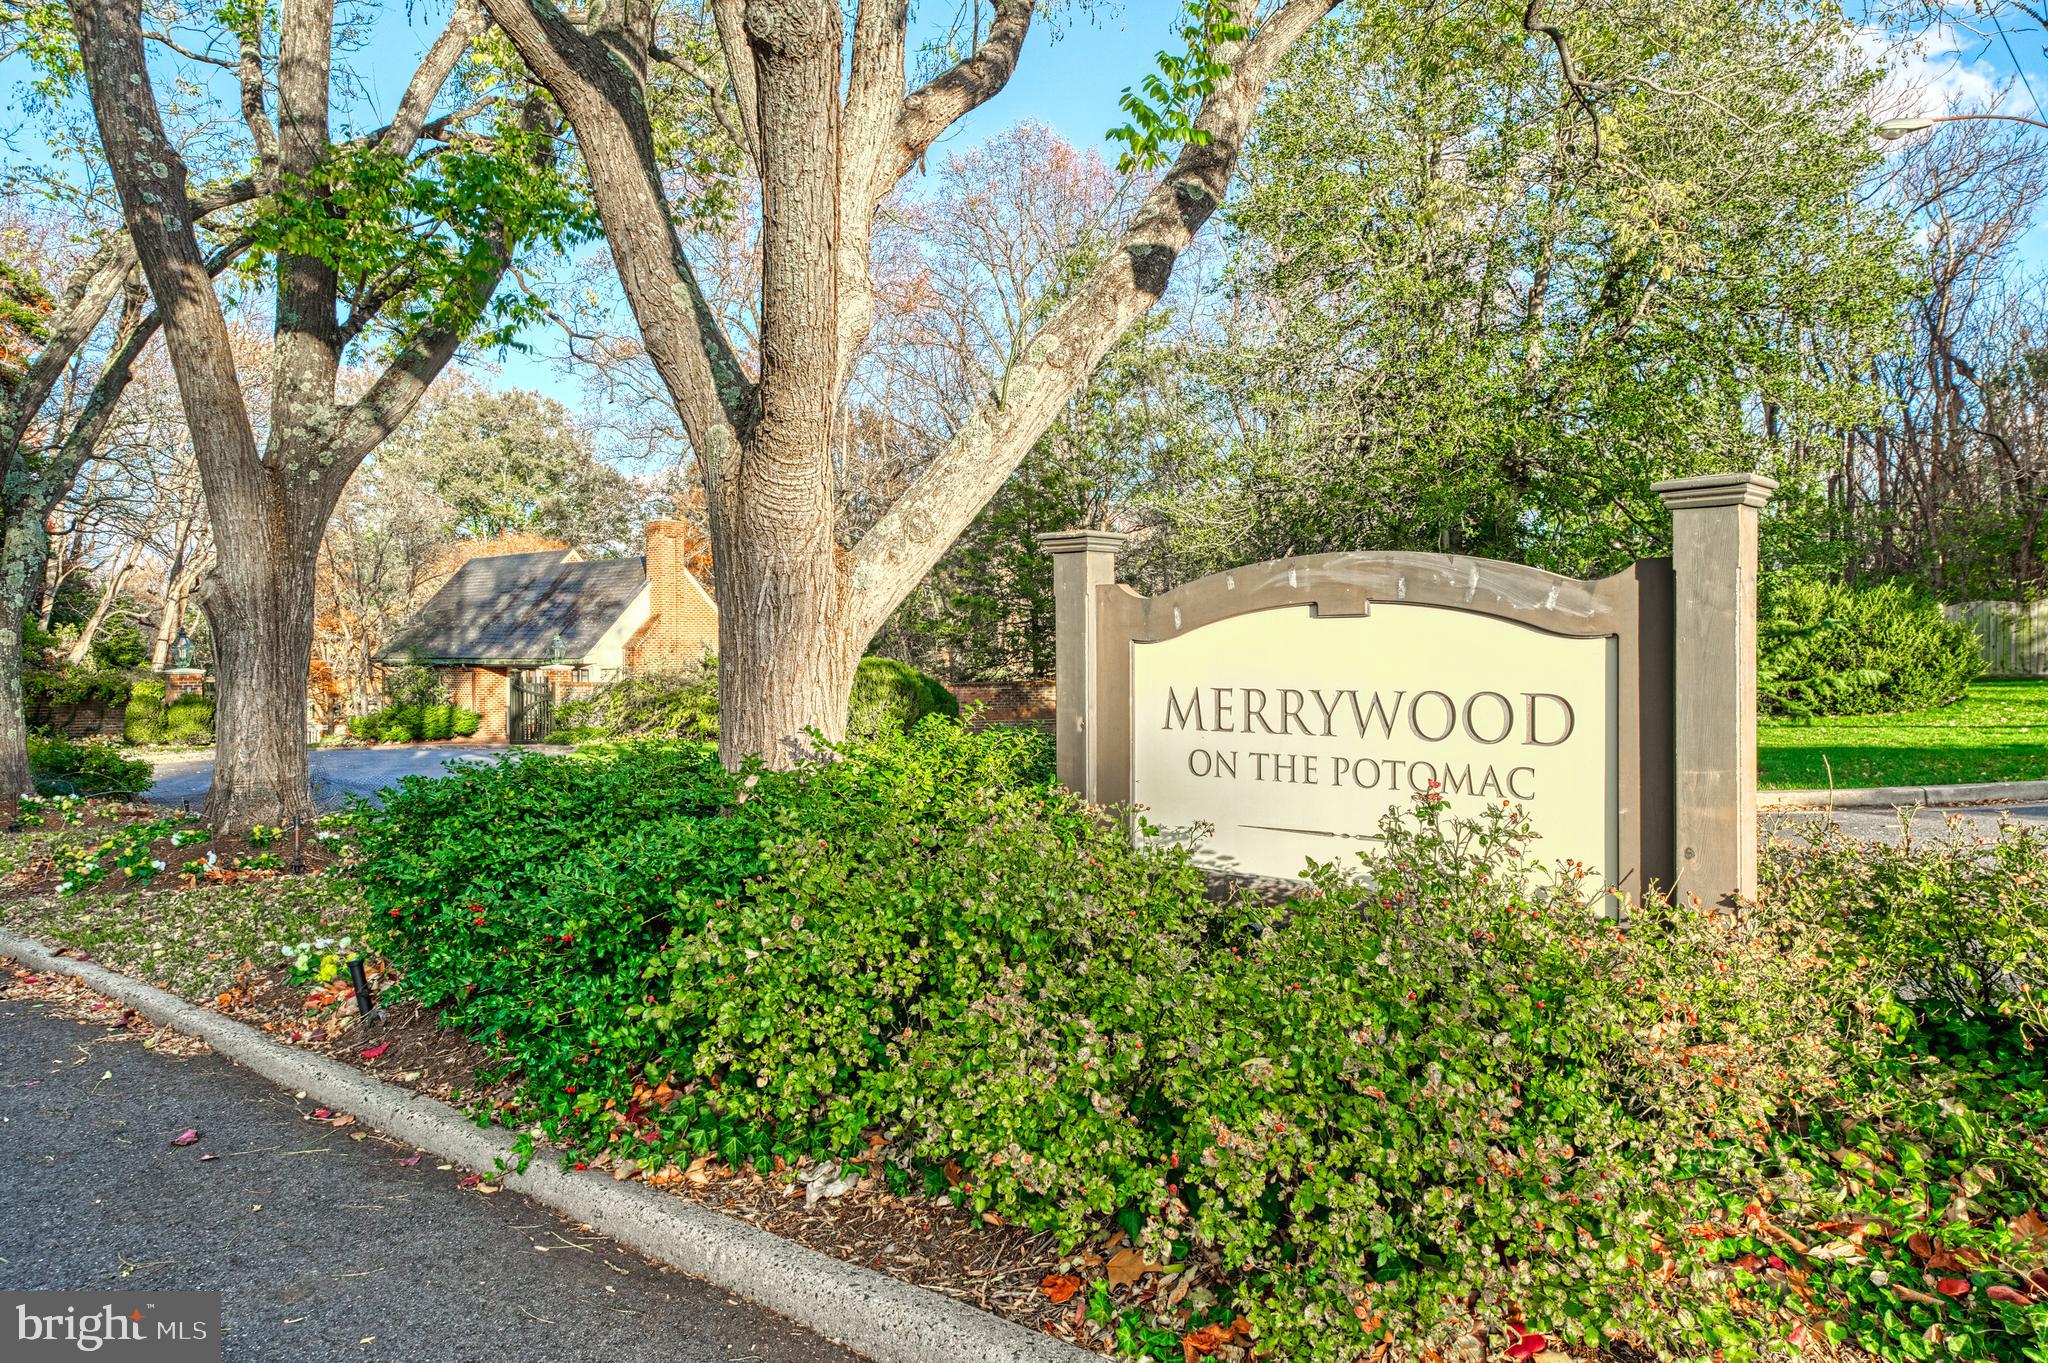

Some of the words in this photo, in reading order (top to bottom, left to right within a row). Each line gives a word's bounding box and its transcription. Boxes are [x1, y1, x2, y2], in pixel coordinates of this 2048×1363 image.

[1161, 685, 1576, 747] MERRYWOOD
[1187, 748, 1239, 781] ON
[1248, 752, 1319, 785] THE
[1331, 757, 1537, 801] POTOMAC
